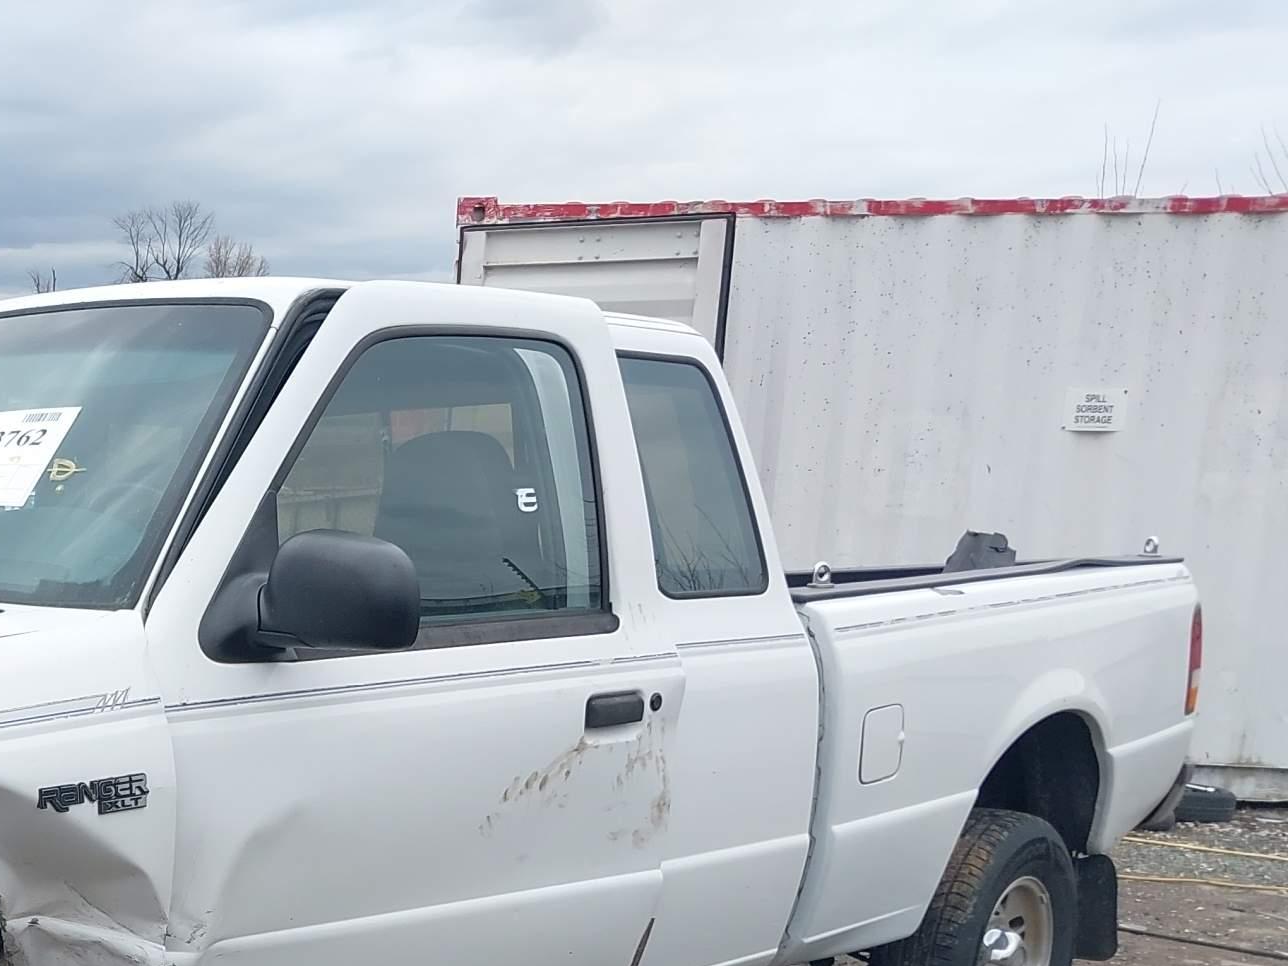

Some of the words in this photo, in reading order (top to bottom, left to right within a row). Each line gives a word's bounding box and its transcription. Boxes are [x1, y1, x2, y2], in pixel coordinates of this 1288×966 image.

[1085, 393, 1108, 403] SPILL
[1075, 404, 1114, 414] SORBENT
[1073, 415, 1113, 425] STORAGE
[105, 796, 144, 812] XLT
